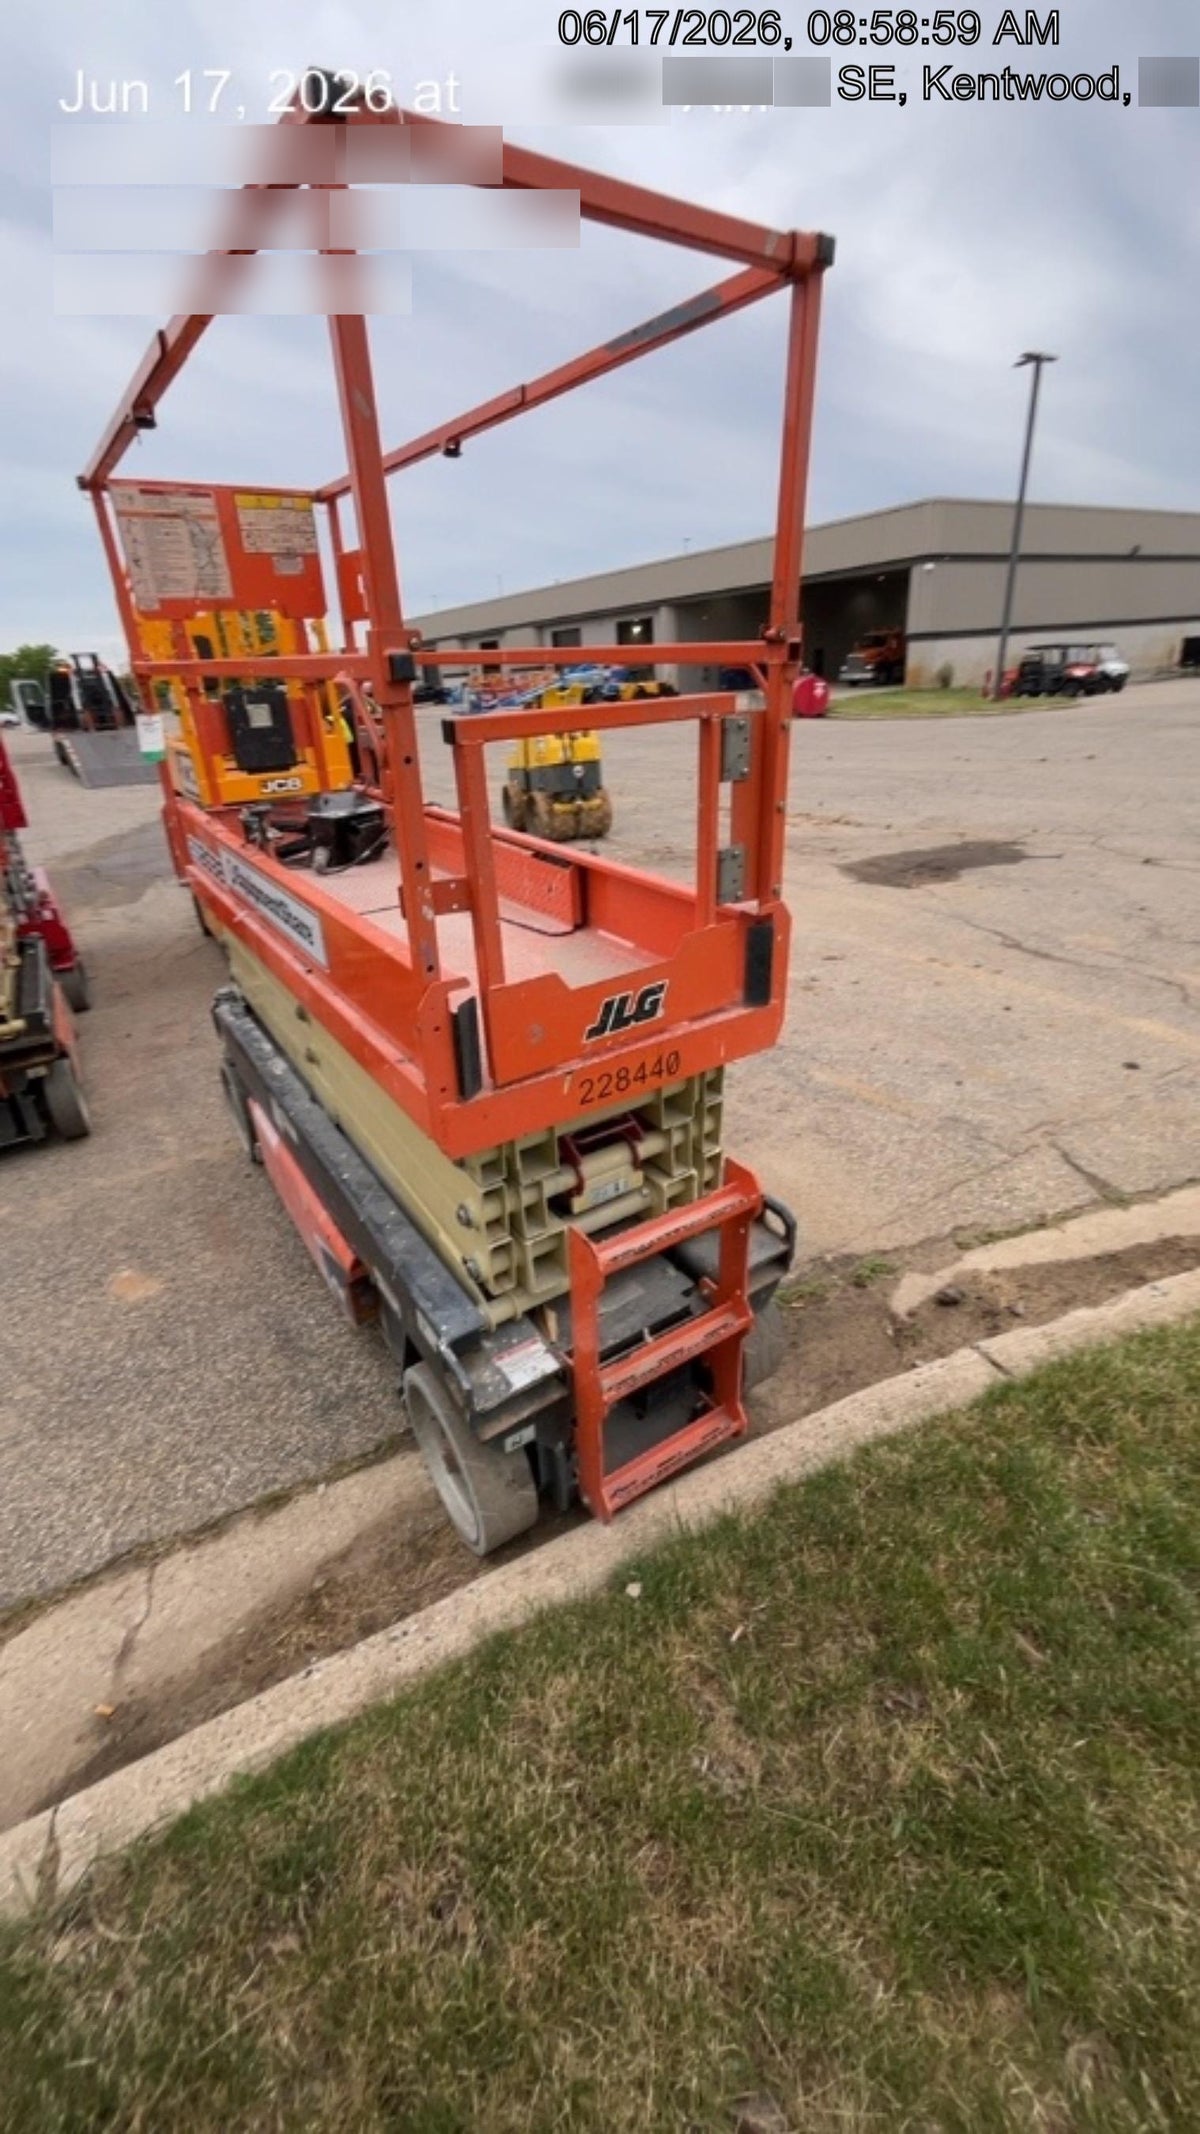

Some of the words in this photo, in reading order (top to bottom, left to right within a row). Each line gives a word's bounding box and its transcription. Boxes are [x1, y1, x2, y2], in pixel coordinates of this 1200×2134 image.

[260, 778, 300, 793] JCB
[583, 980, 668, 1043] JLG
[579, 1051, 681, 1106] 228440
